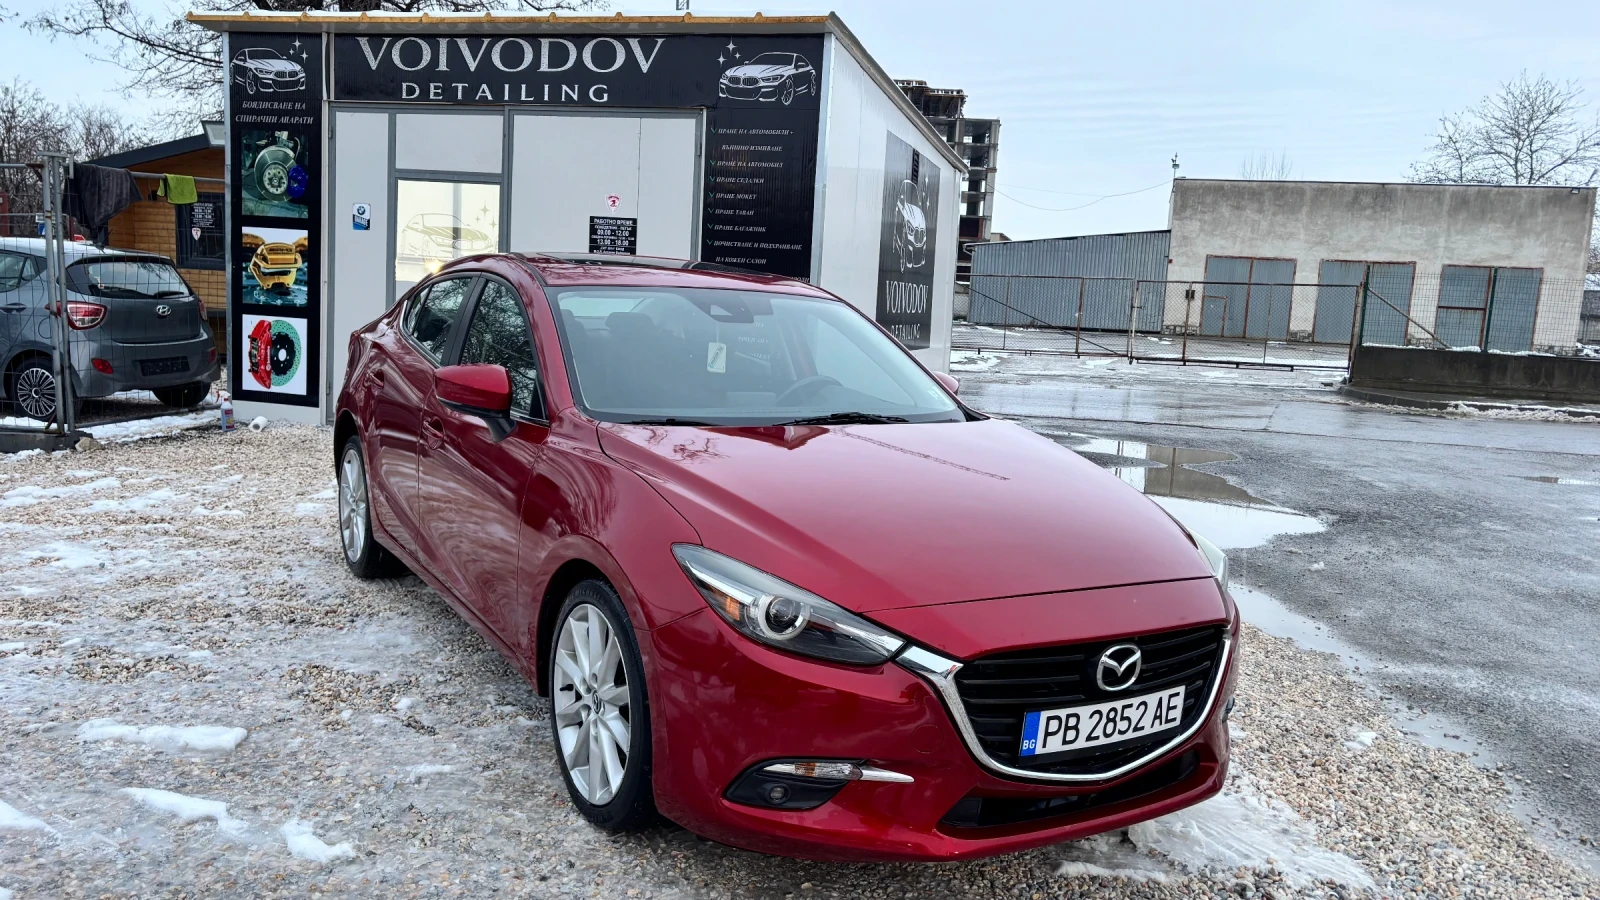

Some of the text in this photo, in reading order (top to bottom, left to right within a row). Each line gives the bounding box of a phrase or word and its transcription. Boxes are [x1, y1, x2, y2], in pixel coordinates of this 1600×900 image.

[355, 36, 666, 74] VOIVODOV
[401, 82, 610, 103] DETAILING
[242, 101, 306, 110] БОЯДИСВАНЕ НА
[235, 114, 314, 125] СПИРАЧНИ АПАРАТИ
[885, 280, 929, 314] VOIVODOV
[891, 323, 920, 340] DETAILING
[1041, 691, 1181, 749] PB 2852 AE
[1022, 739, 1036, 750] BG
